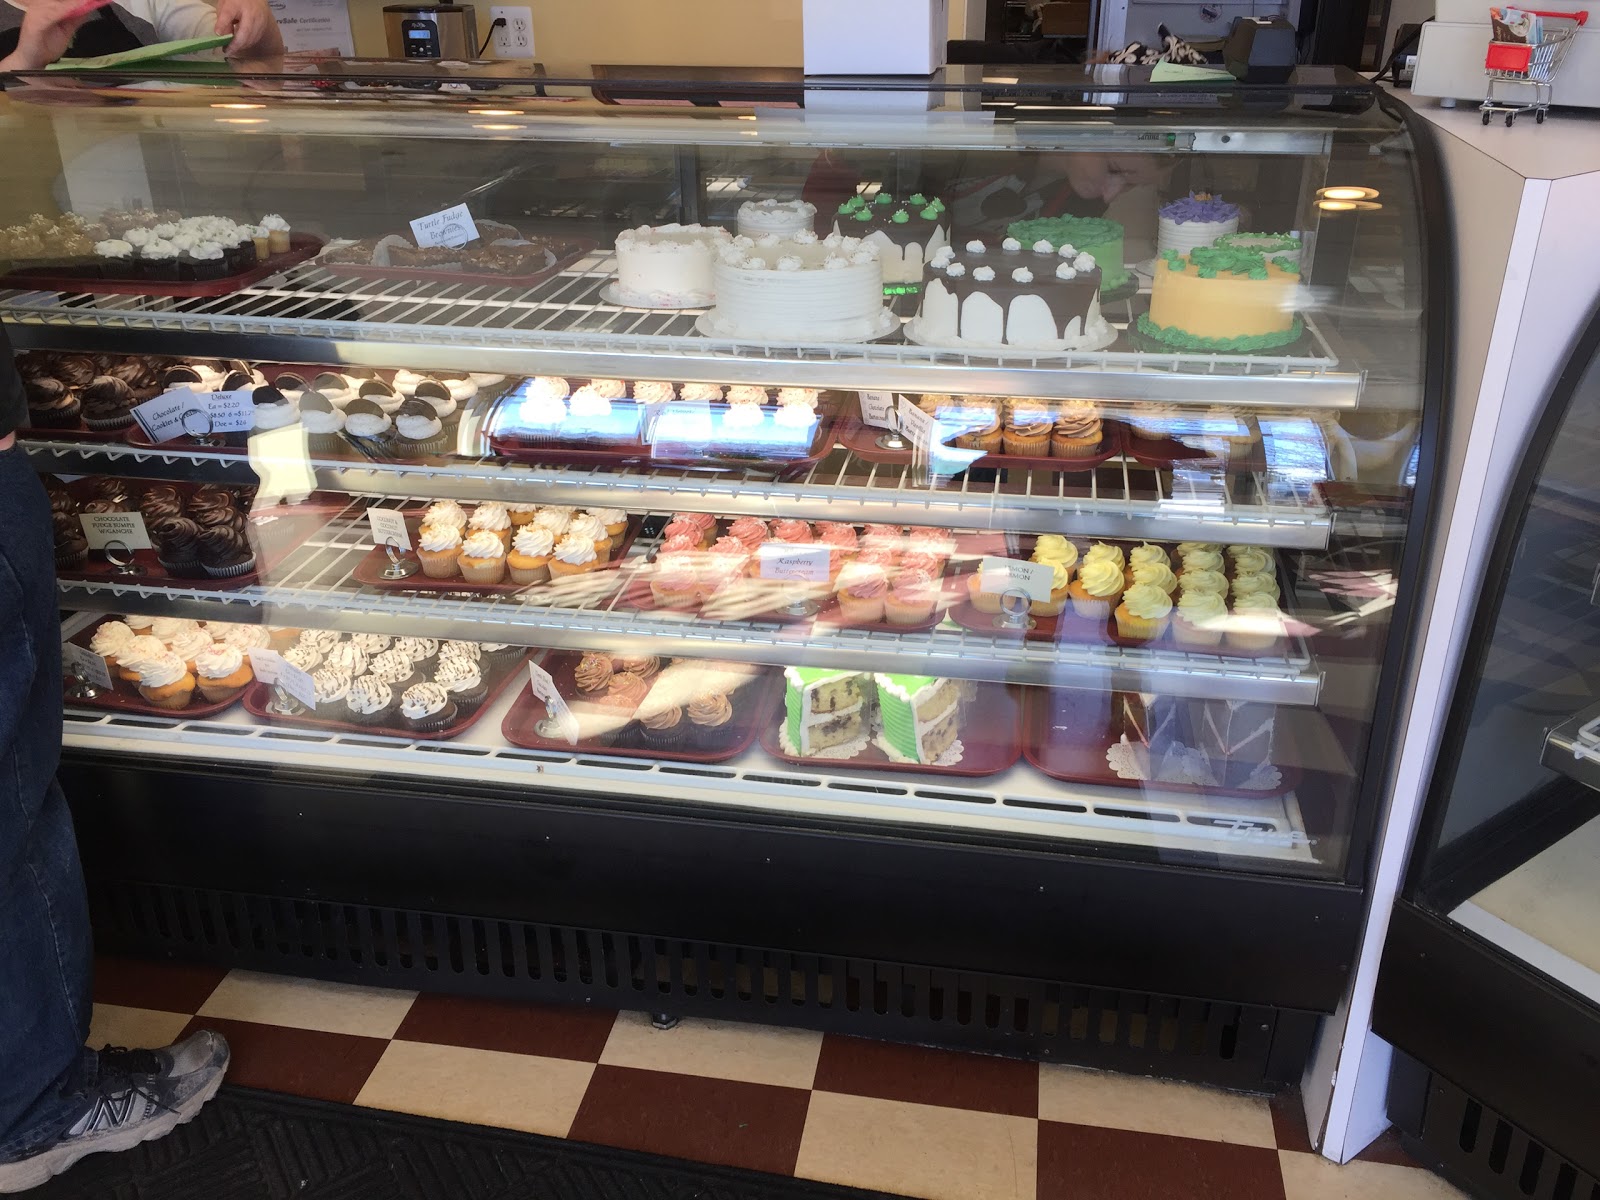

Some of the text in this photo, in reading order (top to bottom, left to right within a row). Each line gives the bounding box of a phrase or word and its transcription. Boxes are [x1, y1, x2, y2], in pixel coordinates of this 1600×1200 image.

[417, 211, 464, 231] Turtle Fudge
[430, 225, 462, 240] Brownies
[211, 393, 232, 401] Deluxe
[152, 405, 180, 421] Chocolate
[152, 418, 174, 432] Cookies
[776, 557, 814, 567] Raspberry
